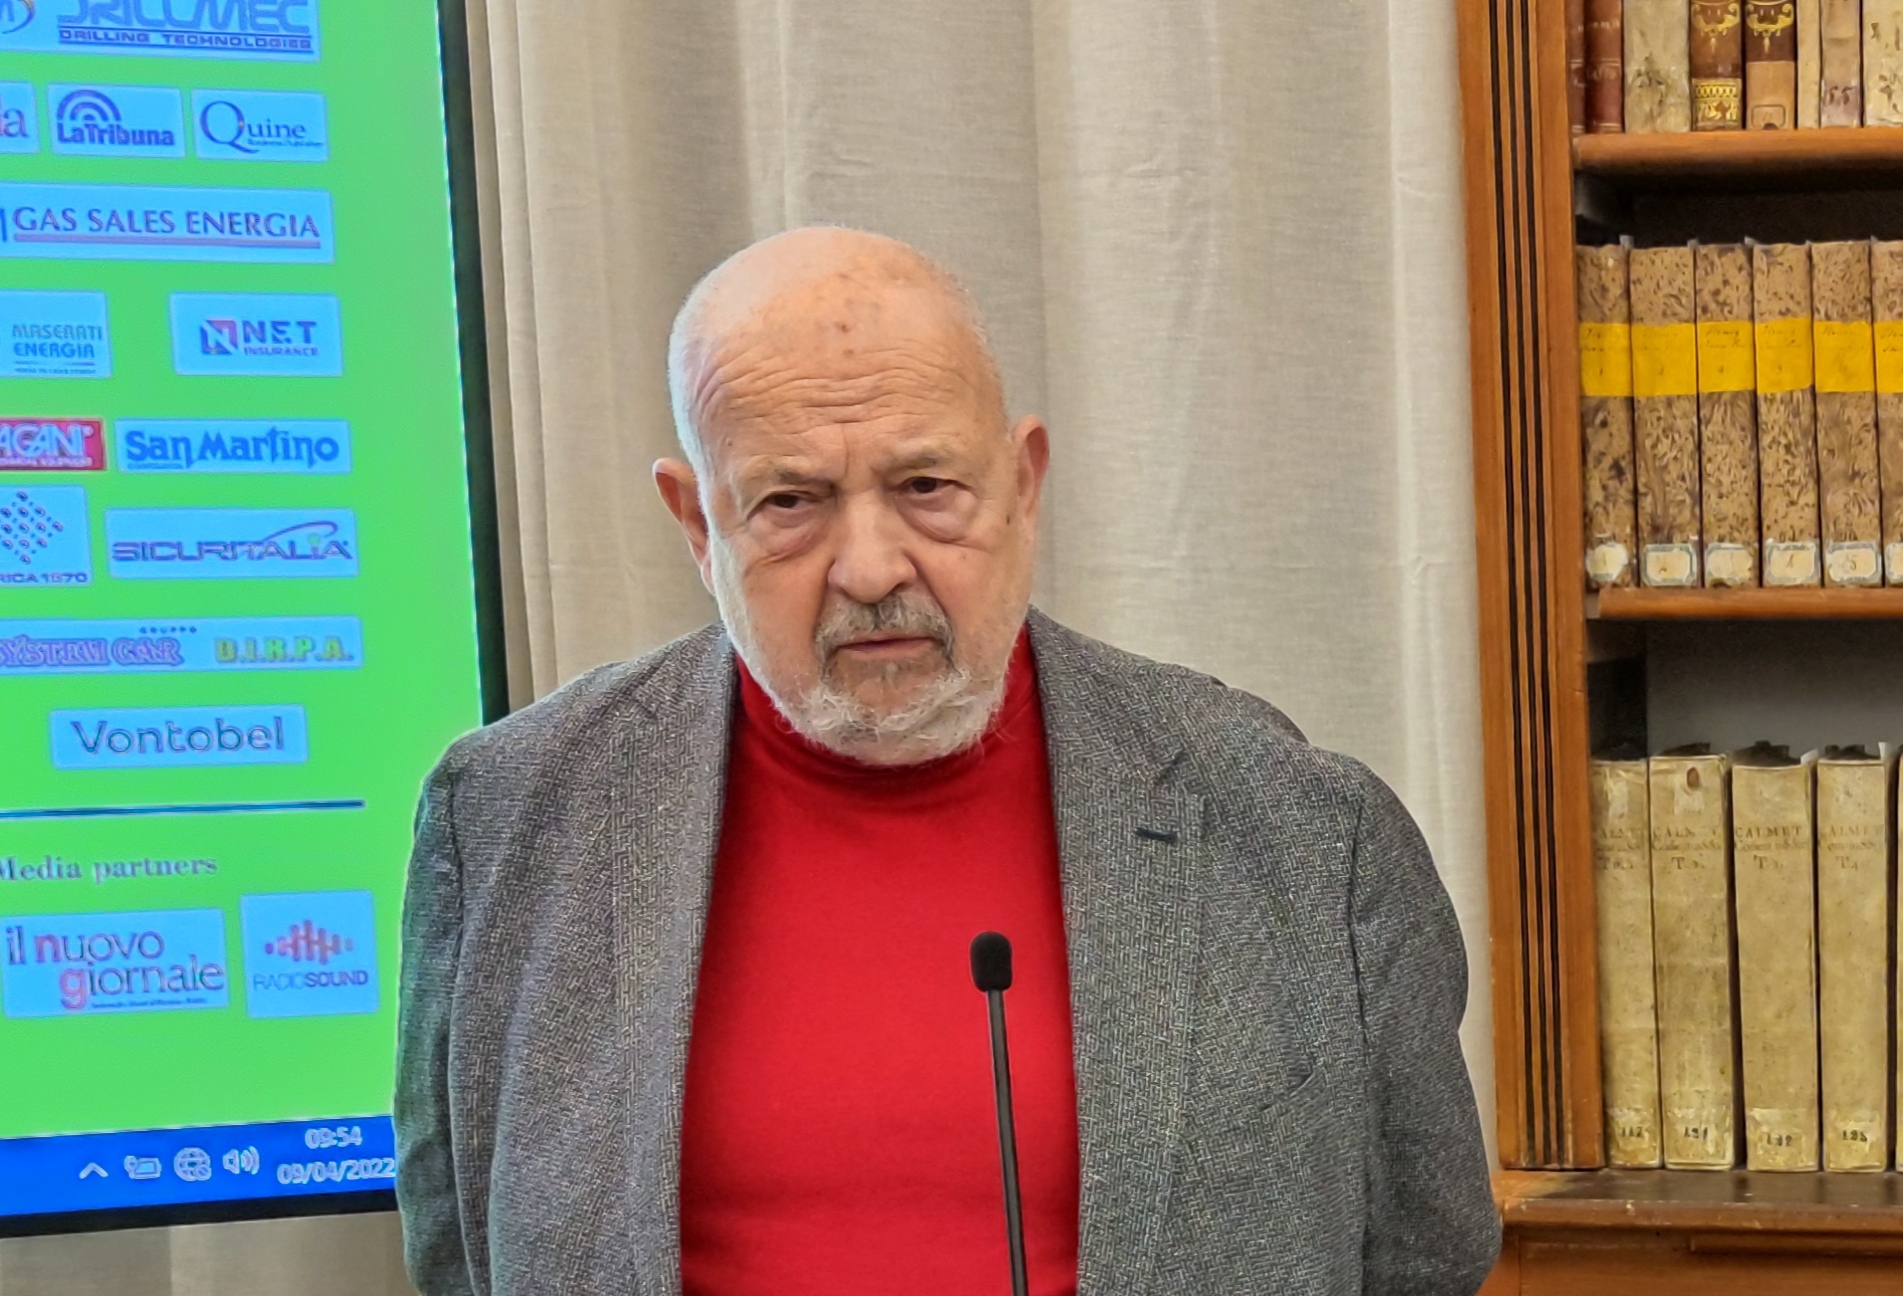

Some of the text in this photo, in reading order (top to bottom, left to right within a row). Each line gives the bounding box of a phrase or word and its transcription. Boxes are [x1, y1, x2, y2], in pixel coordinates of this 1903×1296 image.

[59, 29, 312, 49] DRILLING TECHNOLOGIES
[57, 121, 175, 146] LaTribuna
[200, 101, 308, 154] Quine
[13, 206, 320, 238] GAS SALES ENERGIA
[242, 320, 317, 344] NET
[14, 341, 95, 358] ENERGIA
[125, 426, 340, 469] San Martino
[112, 534, 353, 562] SICURITALIA
[71, 716, 284, 756] Vontobel
[1734, 825, 1802, 839] CALMET
[92, 855, 219, 884] partners
[5, 926, 165, 966] il nuovo
[60, 954, 225, 1011] giornale
[305, 1126, 363, 1150] 09:54
[277, 1157, 396, 1186] 09/04/2022
